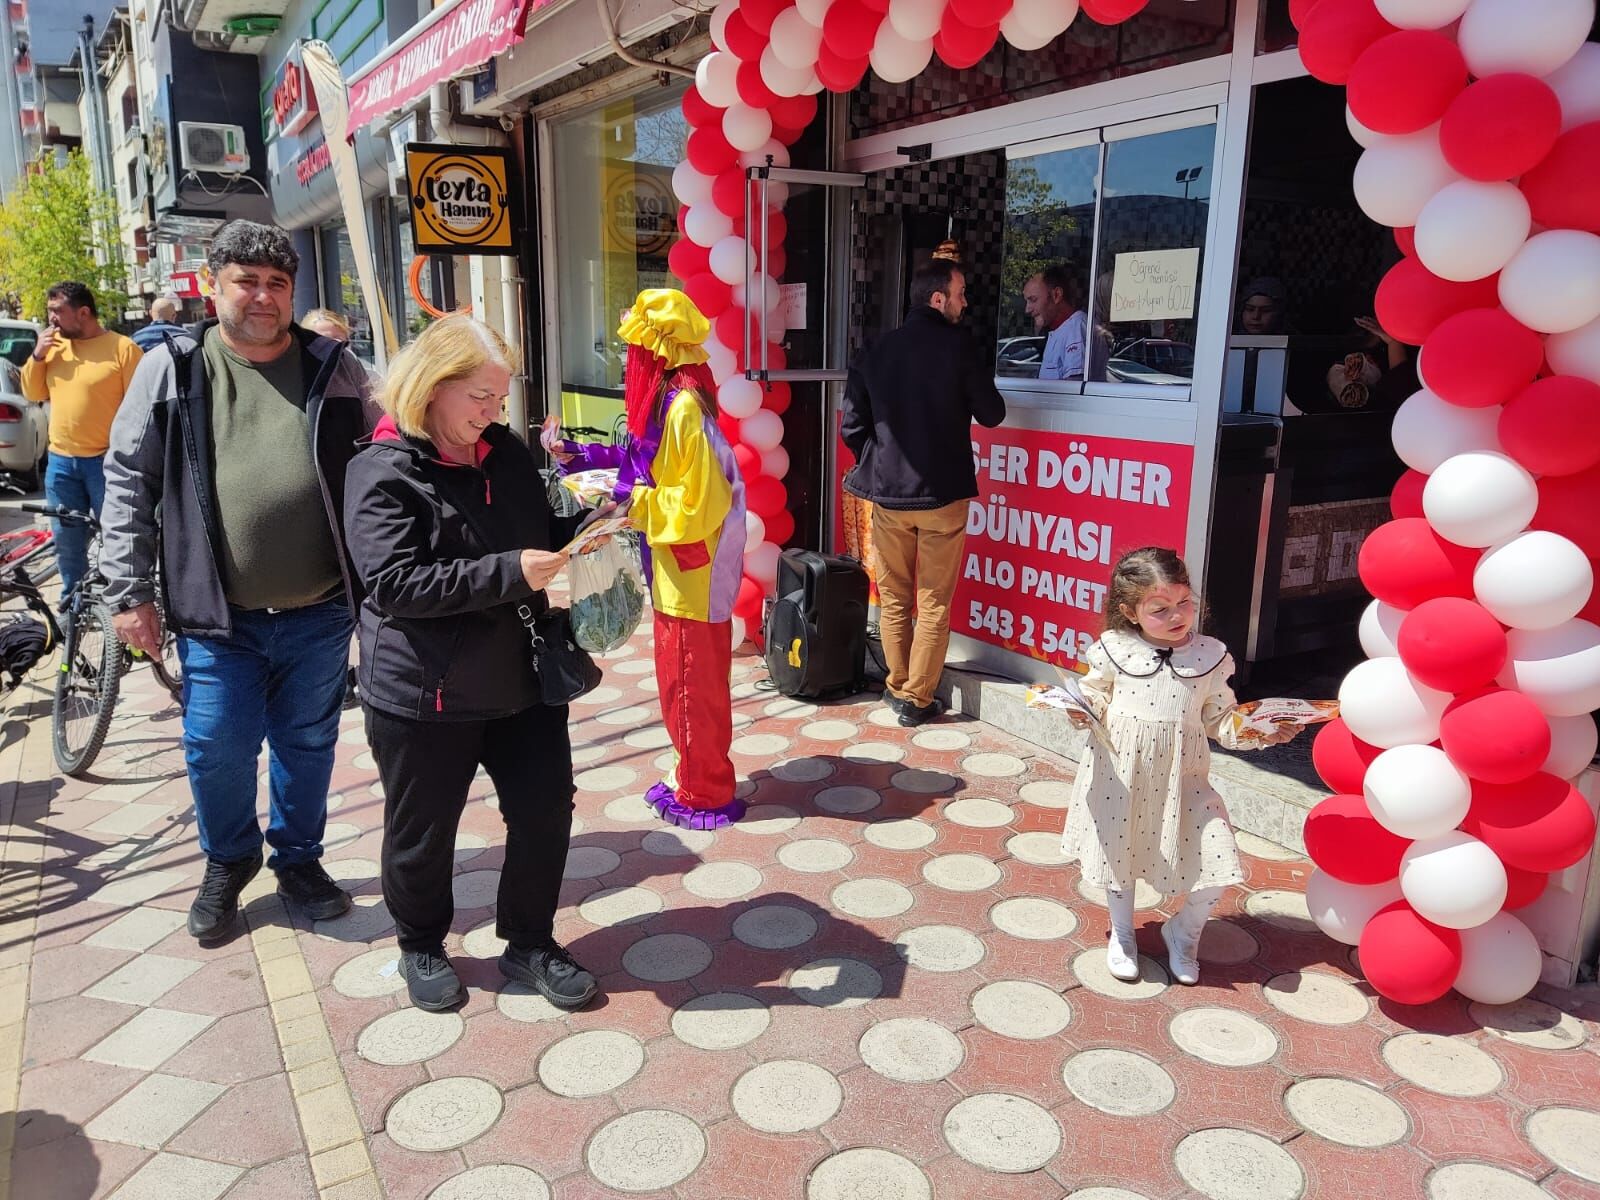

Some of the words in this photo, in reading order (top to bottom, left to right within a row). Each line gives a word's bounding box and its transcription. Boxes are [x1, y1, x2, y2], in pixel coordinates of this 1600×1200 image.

[1037, 441, 1172, 507] DÖNER
[966, 493, 1113, 565] DÜNYASI
[964, 553, 1015, 589] ALO
[1021, 566, 1108, 614] PAKET
[968, 600, 1014, 639] 543
[1019, 615, 1035, 647] 2
